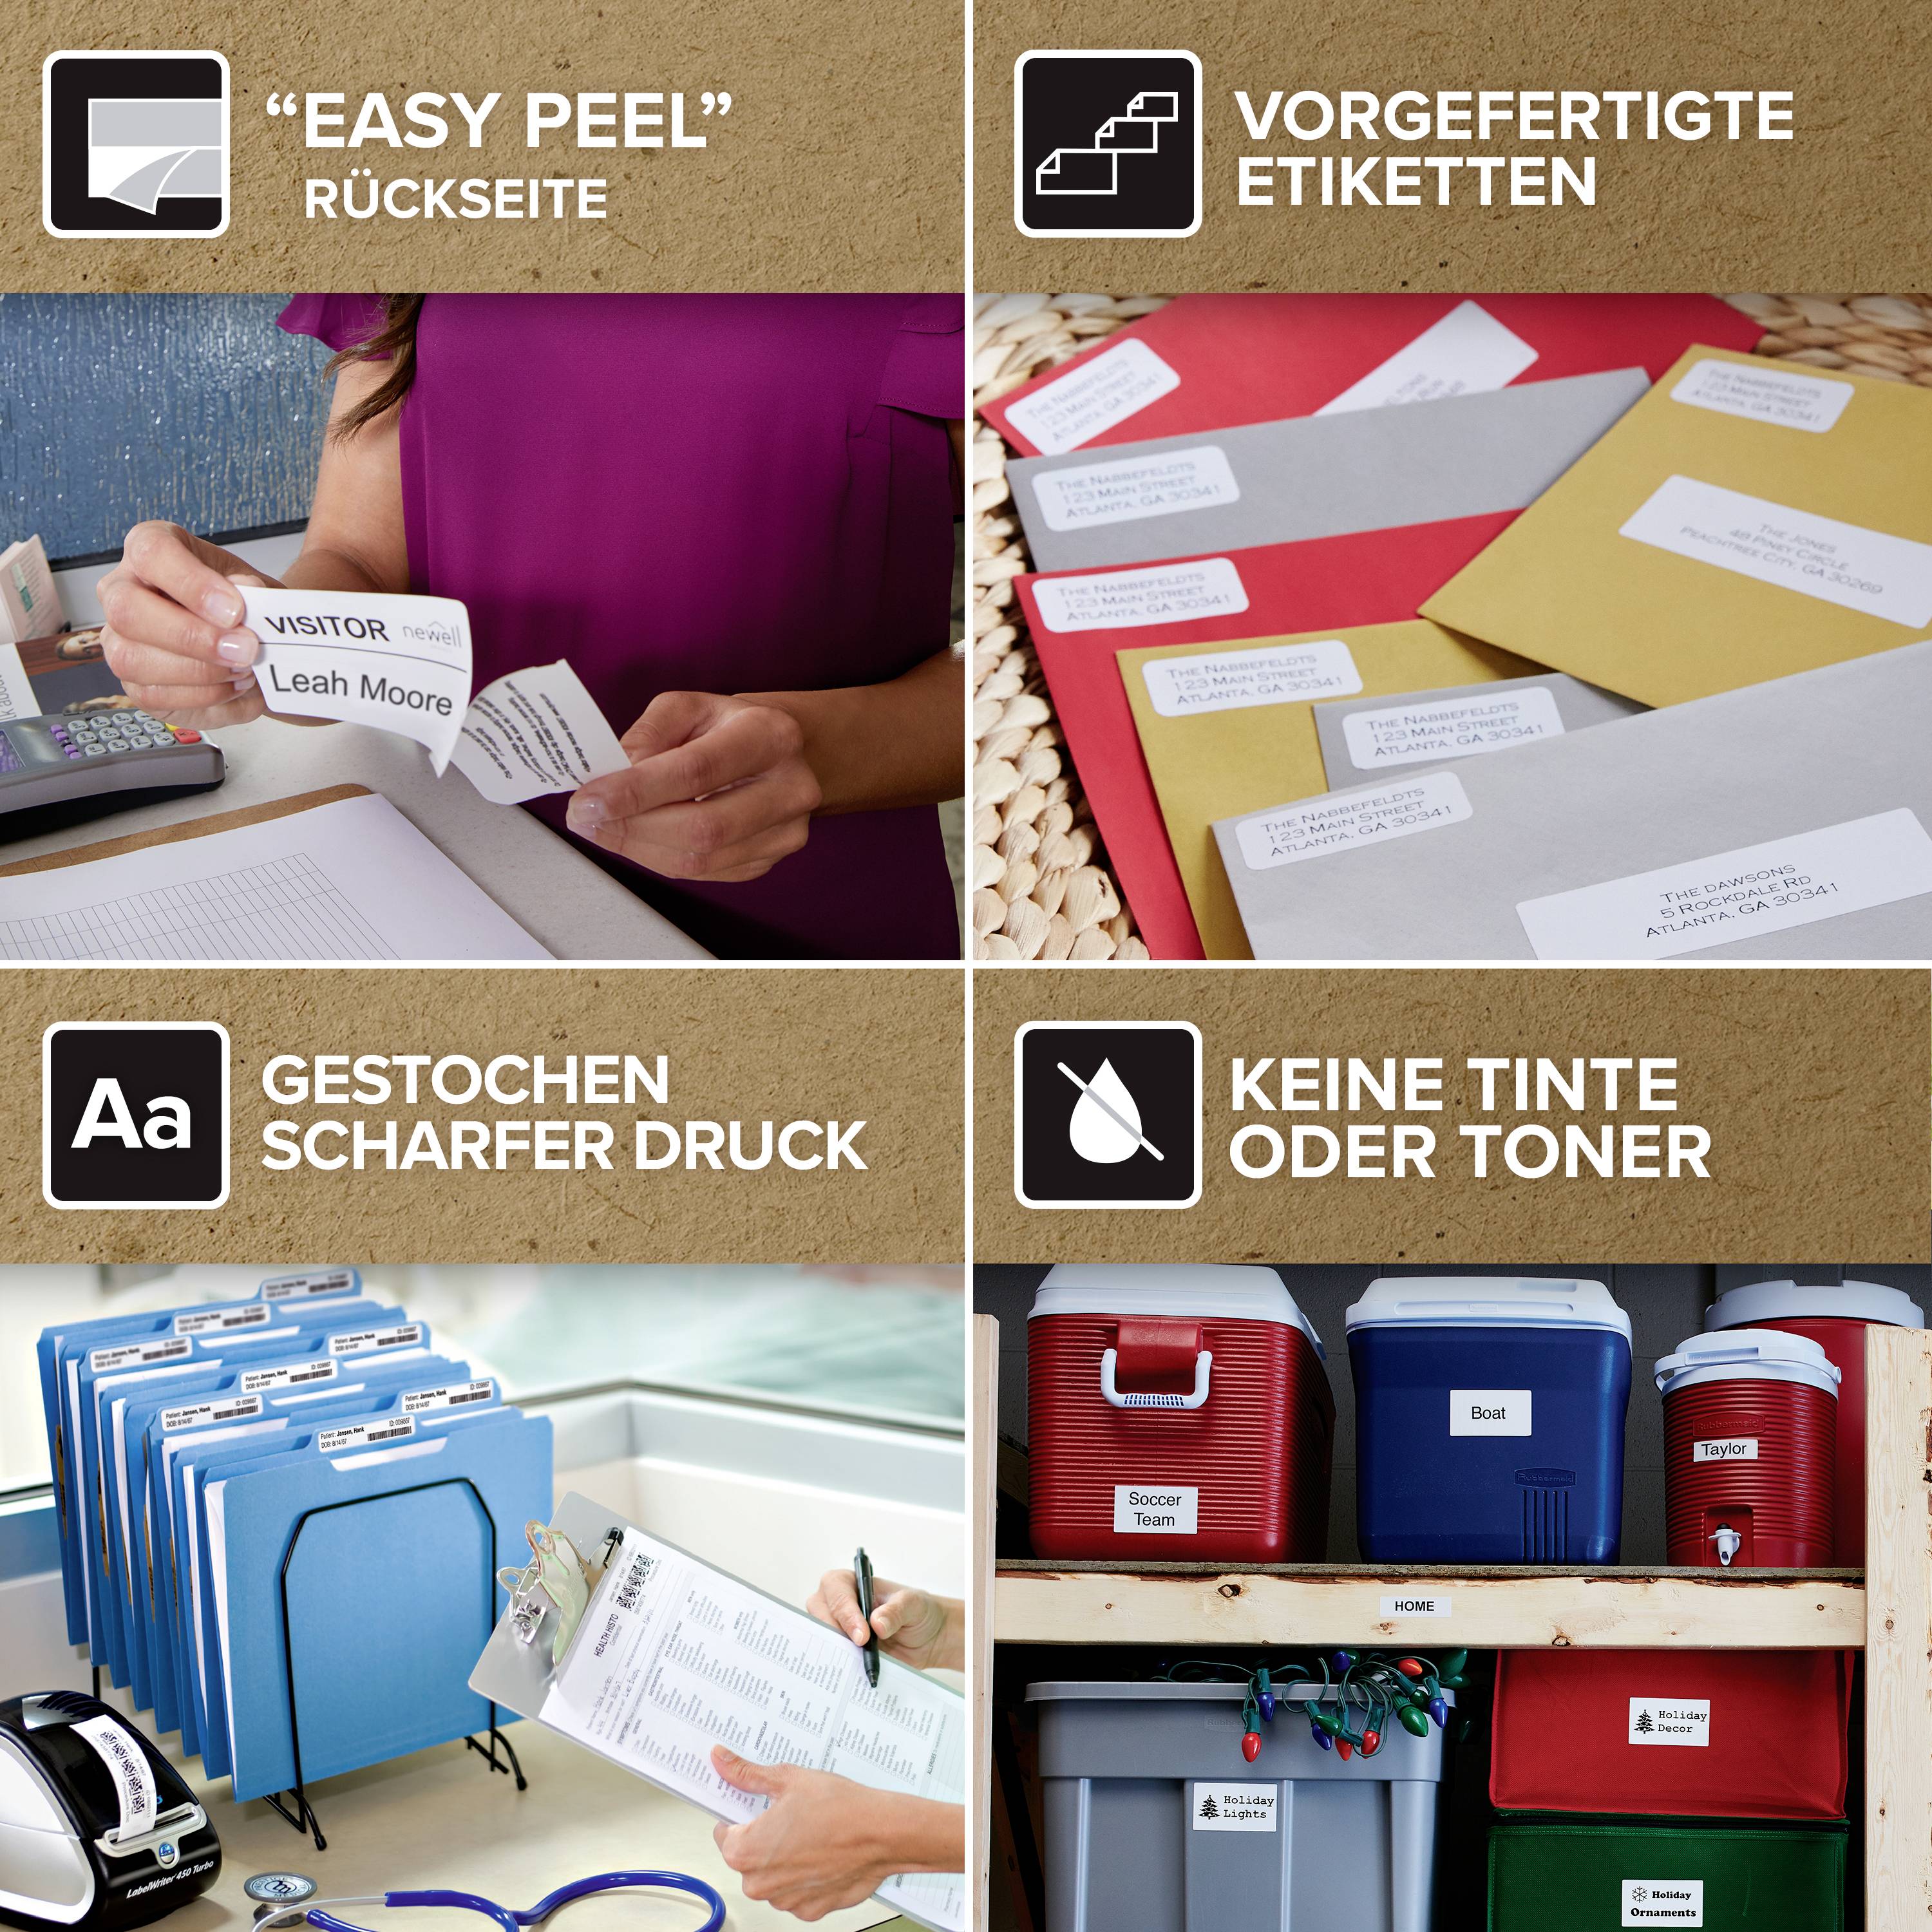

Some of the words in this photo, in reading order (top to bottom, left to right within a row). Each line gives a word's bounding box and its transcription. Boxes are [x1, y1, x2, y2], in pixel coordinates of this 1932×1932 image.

[1057, 482, 1084, 492] THE
[1064, 491, 1094, 504] 123
[1097, 486, 1136, 498] MAIN
[1139, 476, 1195, 493] STREET
[1140, 494, 1164, 506] GA
[1760, 524, 1788, 539] THE
[1680, 526, 1761, 558] PEACHTREE
[1802, 564, 1824, 577] GA
[1795, 549, 1850, 571] CIRCLE
[1057, 587, 1088, 597] THE
[1065, 598, 1097, 609] 123
[1103, 594, 1142, 605] MAIN
[1146, 587, 1204, 601] STREET
[1146, 603, 1172, 614] GA
[1177, 594, 1229, 611] 30341
[265, 616, 390, 641] VISITOR
[402, 625, 462, 648] newell
[1167, 668, 1198, 679] THE
[1205, 654, 1317, 675] NABBEFELDTS
[270, 665, 348, 696] Leah
[361, 674, 452, 715] Moore
[1175, 677, 1208, 692] 123
[1213, 675, 1254, 687] MAIN
[1257, 668, 1316, 682] STREET
[1258, 683, 1284, 695] GA
[1287, 677, 1342, 692] 30341
[1368, 719, 1399, 731] THE
[1404, 702, 1519, 725] NABBEFELDTS
[1374, 731, 1407, 743] 123
[1412, 726, 1454, 737] MAIN
[1457, 716, 1518, 732] STREET
[1456, 734, 1484, 745] GA
[1488, 724, 1543, 740] 30341
[1262, 819, 1296, 833] THE
[1302, 788, 1425, 823] NABBEFELDTS
[1359, 822, 1388, 835] GA
[1392, 806, 1452, 828] 30341
[1269, 828, 1305, 844] 123
[1309, 817, 1354, 834] MAIN
[1359, 800, 1424, 822] STREET
[1660, 888, 1701, 903] THE
[1705, 864, 1795, 893] DAWSONS
[1660, 908, 1674, 918] 5
[1679, 884, 1781, 914] ROCKDALE
[1783, 876, 1811, 888] RD
[1739, 901, 1770, 914] GA
[1772, 883, 1838, 907] 30341
[395, 1417, 410, 1426] 009867
[1472, 1406, 1506, 1419] Boat
[1697, 1419, 1759, 1432] Rubbermaid
[1701, 1442, 1747, 1459] Taylor
[1517, 1473, 1574, 1482] Rubbermaid
[1129, 1492, 1182, 1506] Soccer
[1133, 1512, 1175, 1526] Team
[1395, 1600, 1435, 1611] HOME
[593, 1631, 611, 1657] HEALTH
[605, 1613, 618, 1633] HISTO
[1658, 1710, 1708, 1722] Holiday
[1658, 1724, 1693, 1733] Decor
[926, 1752, 936, 1775] ALLERGIES
[1224, 1795, 1274, 1807] Holiday
[1223, 1809, 1267, 1821] Lights
[126, 1874, 175, 1899] LabelWriter
[176, 1868, 191, 1880] 450
[193, 1861, 214, 1874] Turbo
[1652, 1891, 1692, 1900] Holiday
[1630, 1908, 1696, 1917] Ornaments
